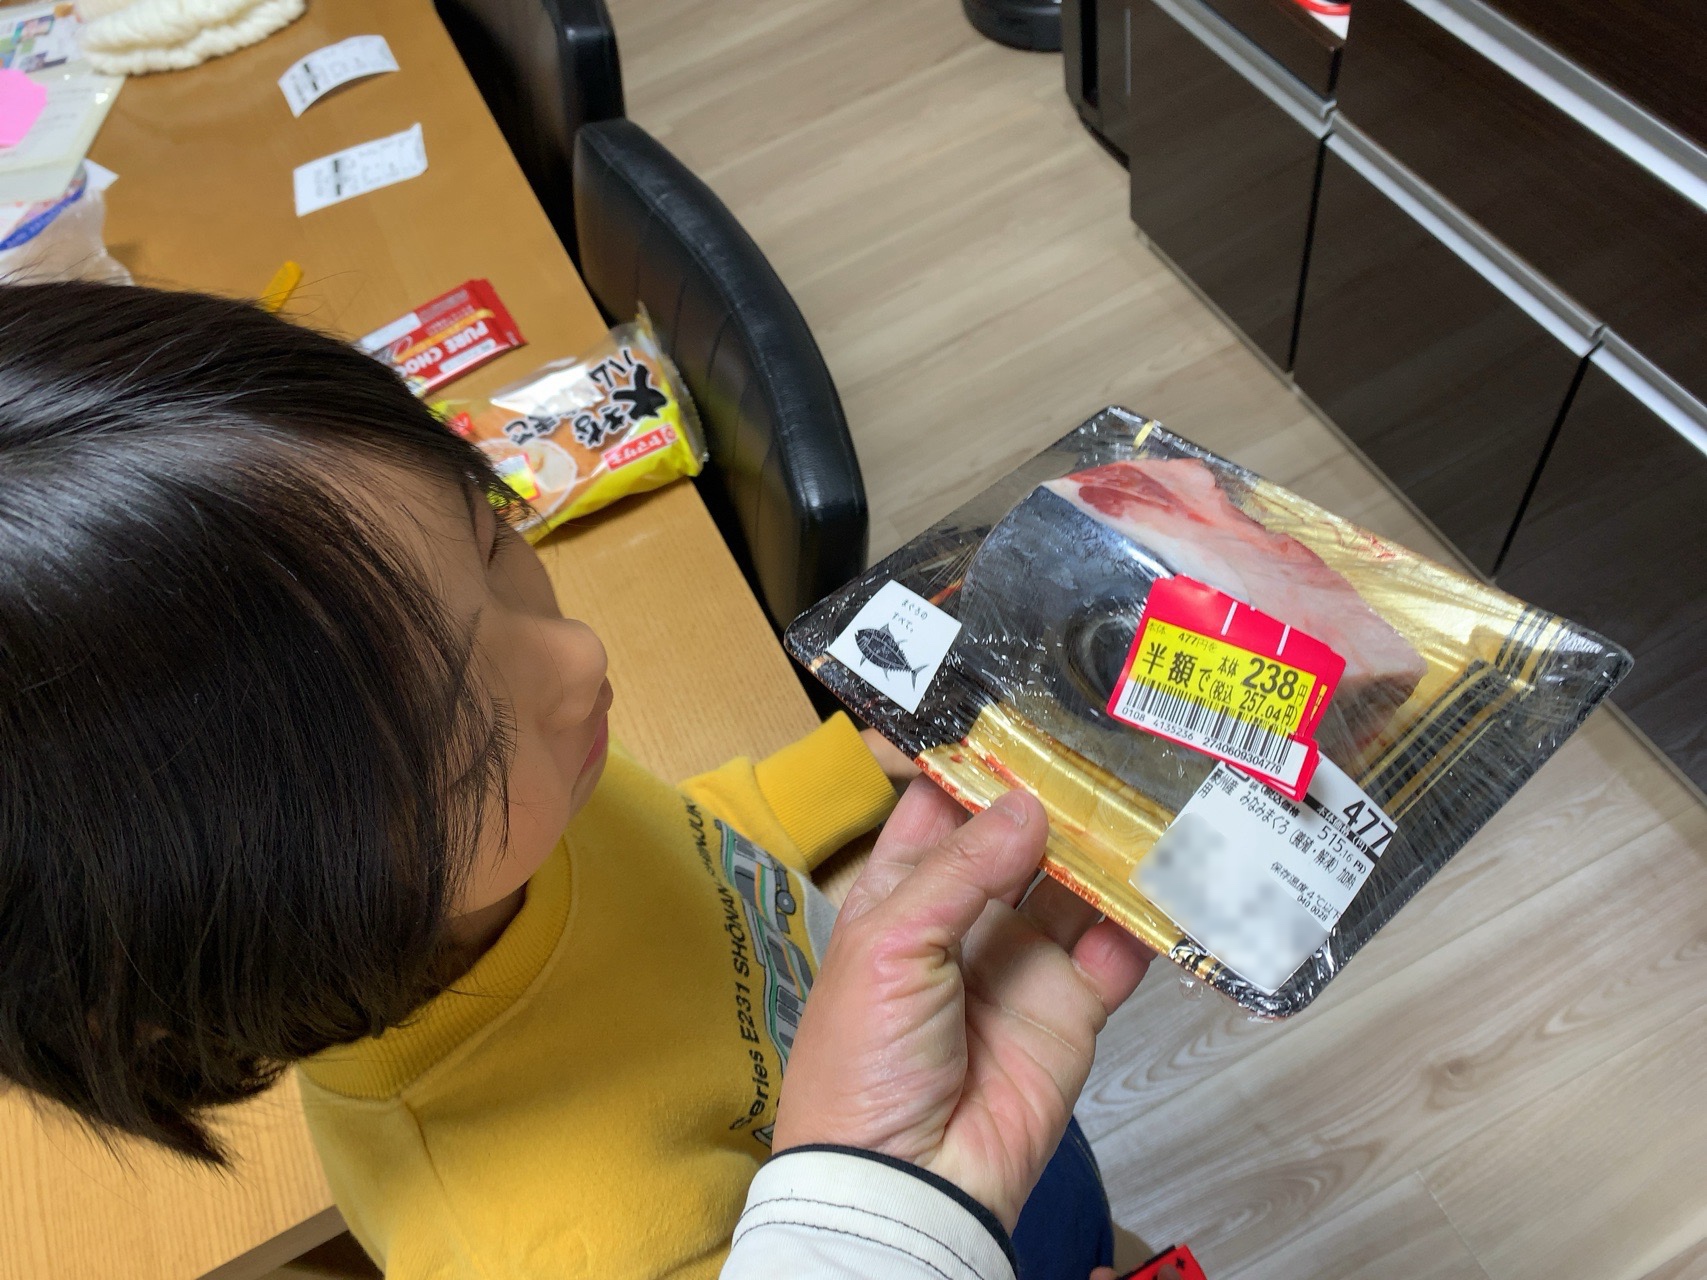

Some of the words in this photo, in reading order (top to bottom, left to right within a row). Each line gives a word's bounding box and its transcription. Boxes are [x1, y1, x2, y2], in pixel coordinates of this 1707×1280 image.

[444, 320, 489, 354] PURE
[1217, 655, 1240, 679] 本体
[1121, 707, 1146, 722] 0108
[1153, 719, 1194, 742] 4135236
[1202, 737, 1282, 775] 2740609304779
[1343, 799, 1394, 850] 477
[735, 981, 760, 1045] E231
